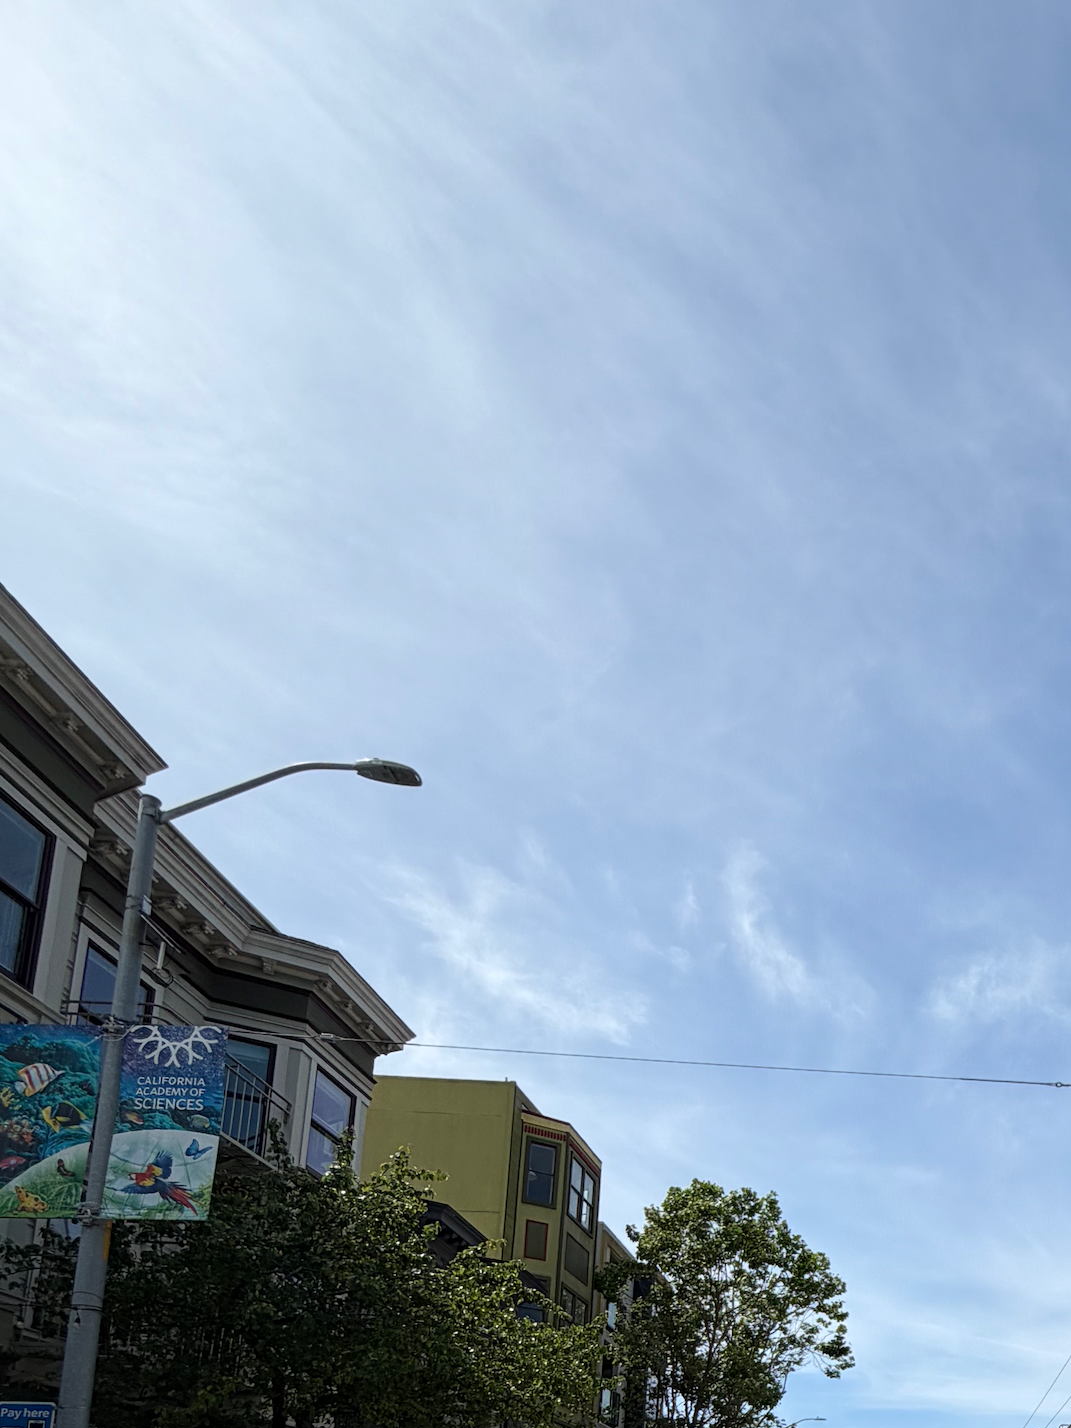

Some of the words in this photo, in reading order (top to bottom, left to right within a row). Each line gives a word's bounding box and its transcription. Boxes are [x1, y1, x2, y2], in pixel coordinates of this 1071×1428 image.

[137, 1076, 206, 1087] CALIFORNIA
[135, 1087, 187, 1097] ACADEMY
[188, 1087, 206, 1097] OF
[134, 1098, 204, 1111] SCIENCES
[0, 1408, 22, 1420] Pay
[23, 1408, 50, 1418] here
